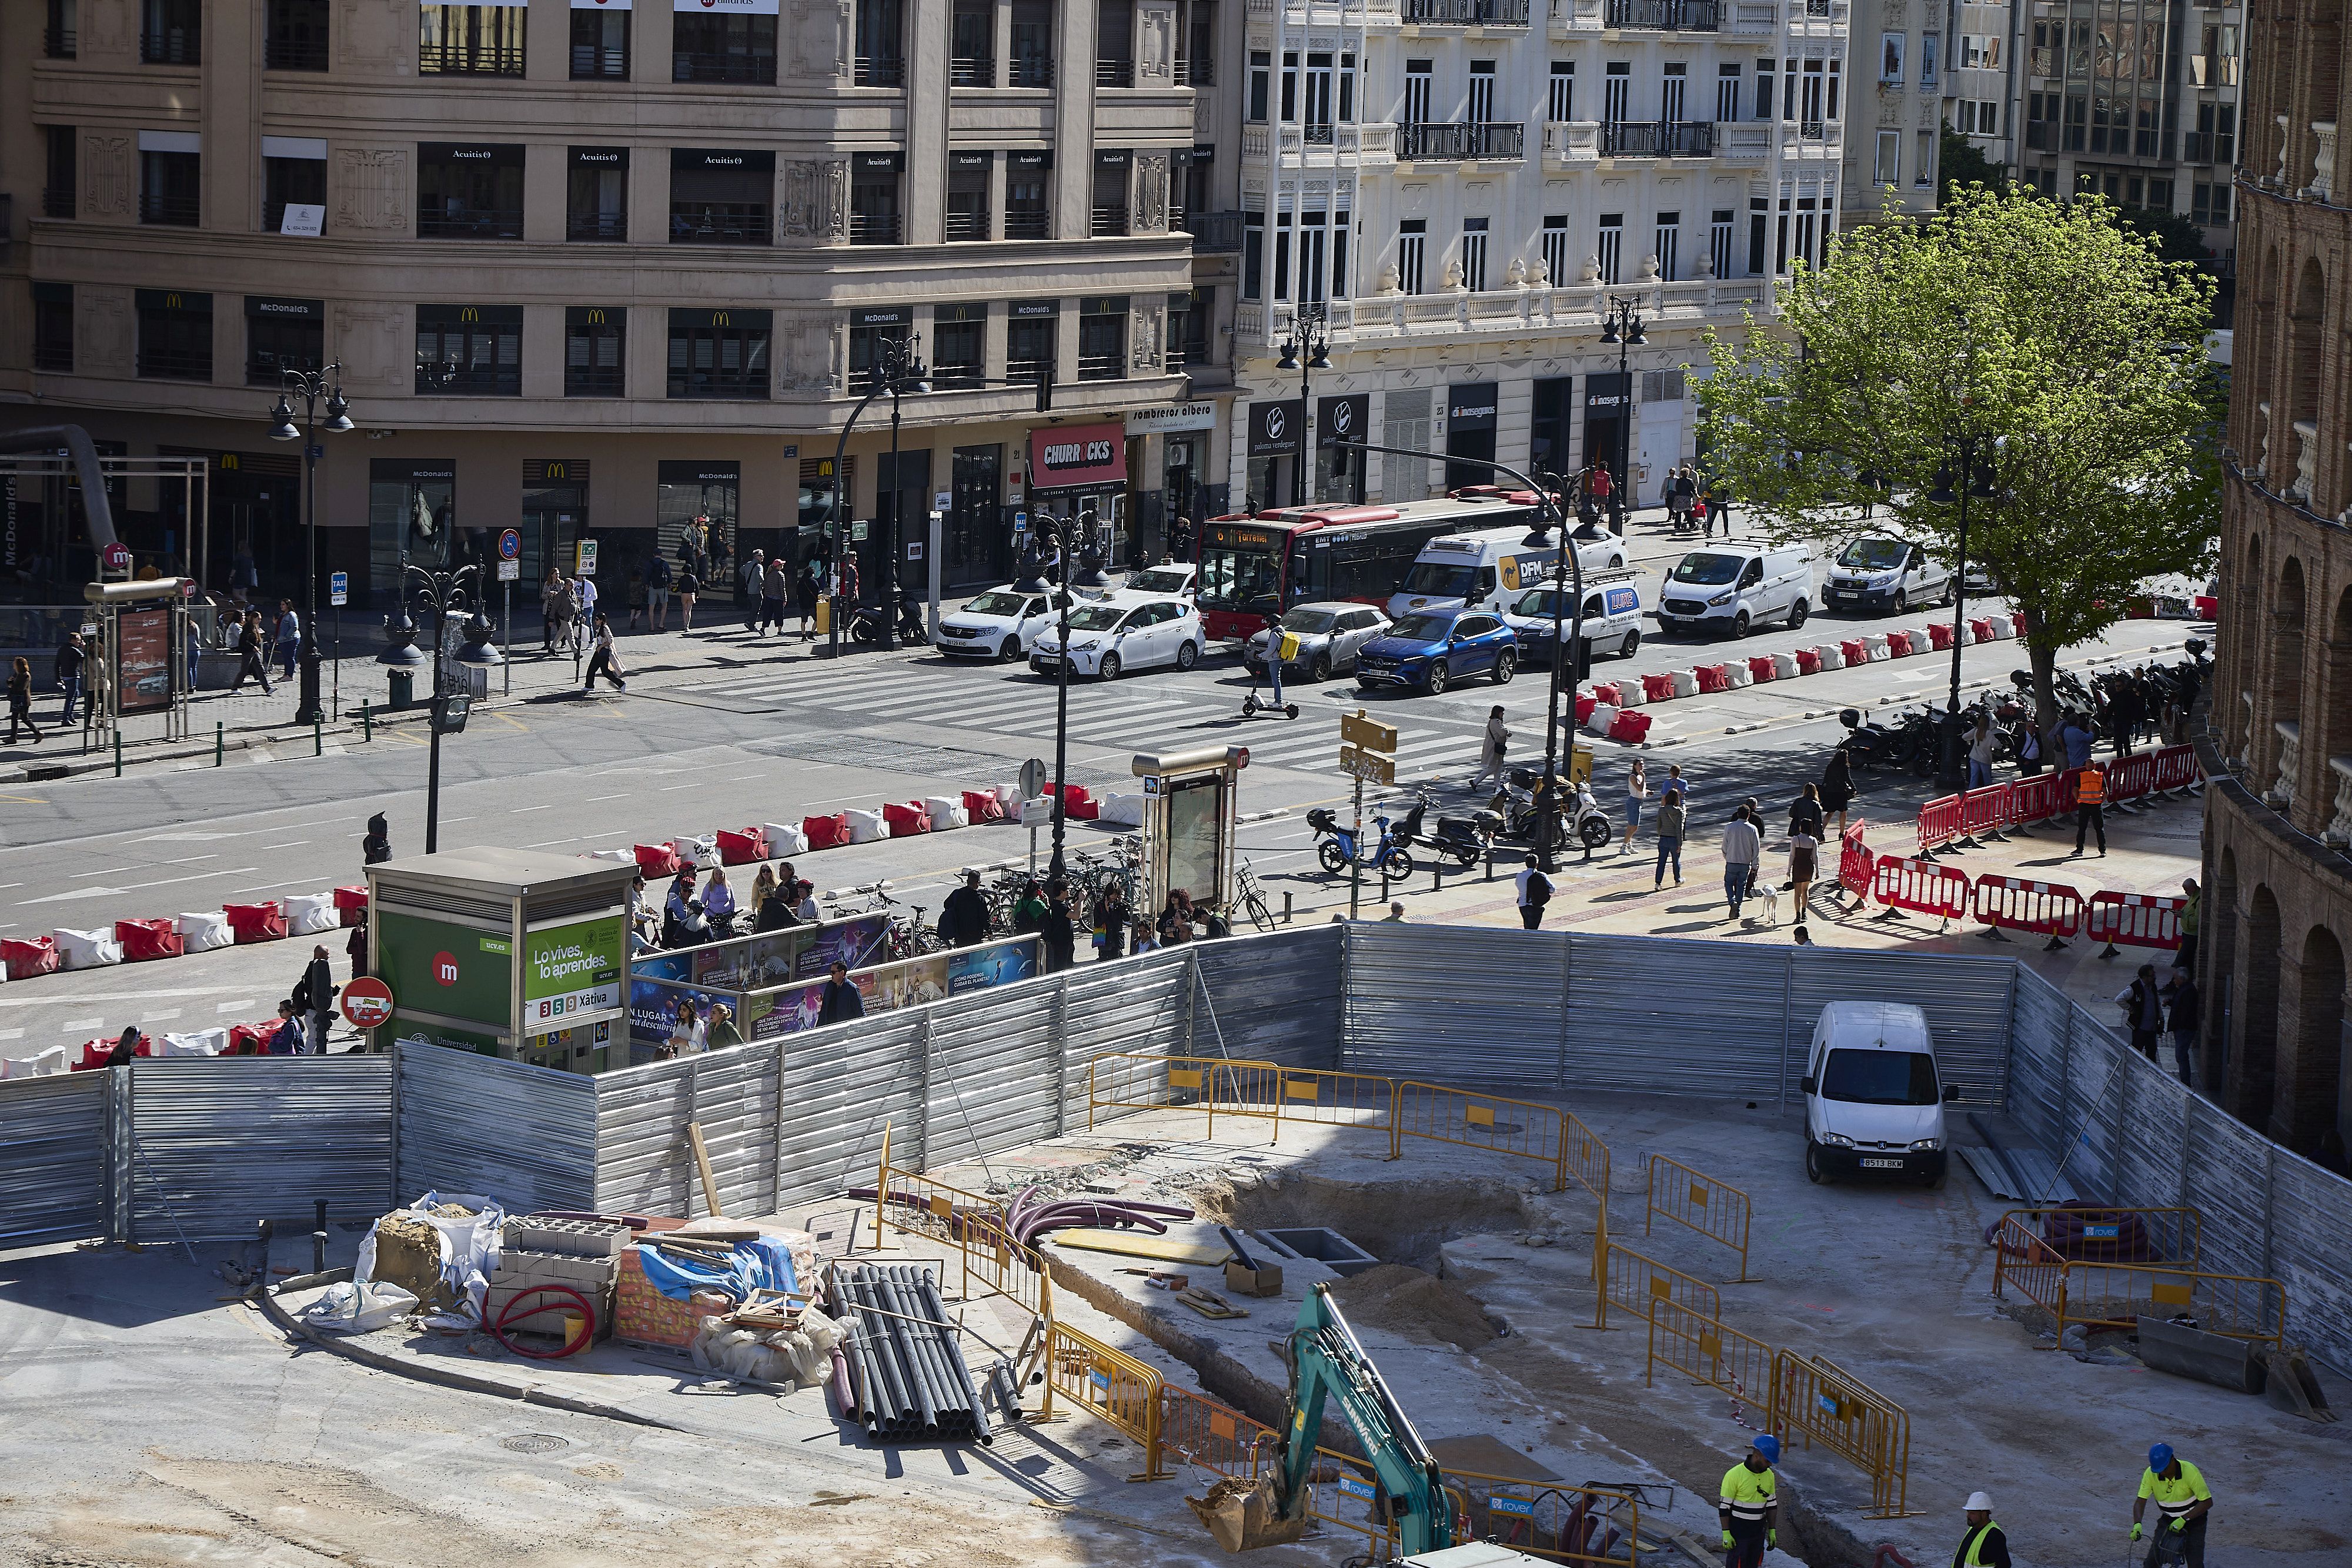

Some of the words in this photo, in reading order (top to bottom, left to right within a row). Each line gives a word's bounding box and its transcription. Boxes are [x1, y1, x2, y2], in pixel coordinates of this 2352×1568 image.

[260, 303, 308, 313] McDonald's
[1018, 306, 1050, 314] McDonald's
[864, 313, 898, 322] McDonald's
[1133, 408, 1178, 420] sombreros
[1182, 405, 1210, 416] albero
[1436, 407, 1443, 416] 23
[1254, 442, 1271, 452] paloma
[1272, 440, 1295, 449] verdeguer
[1322, 435, 1337, 445] palom
[1014, 450, 1020, 459] 21
[1044, 440, 1111, 466] CHURROCKS
[1217, 529, 1224, 541] 6
[1520, 560, 1542, 578] DFM
[1611, 591, 1633, 610] LUXE
[486, 942, 505, 952] ucv.es
[534, 950, 549, 965] Lo
[551, 944, 583, 961] vives,
[540, 964, 551, 979] lo
[552, 954, 607, 979] aprendes.
[542, 1004, 548, 1015] 3
[556, 1001, 561, 1012] 5
[568, 998, 574, 1010] 9
[579, 992, 606, 1007] Xàtiva
[637, 1009, 667, 1022] LUGAR
[437, 1037, 476, 1051] Universidad
[1095, 1375, 1107, 1387] rover
[1342, 1396, 1378, 1456] SUNWARD
[1350, 1485, 1373, 1498] rover
[1503, 1502, 1530, 1513] rover
